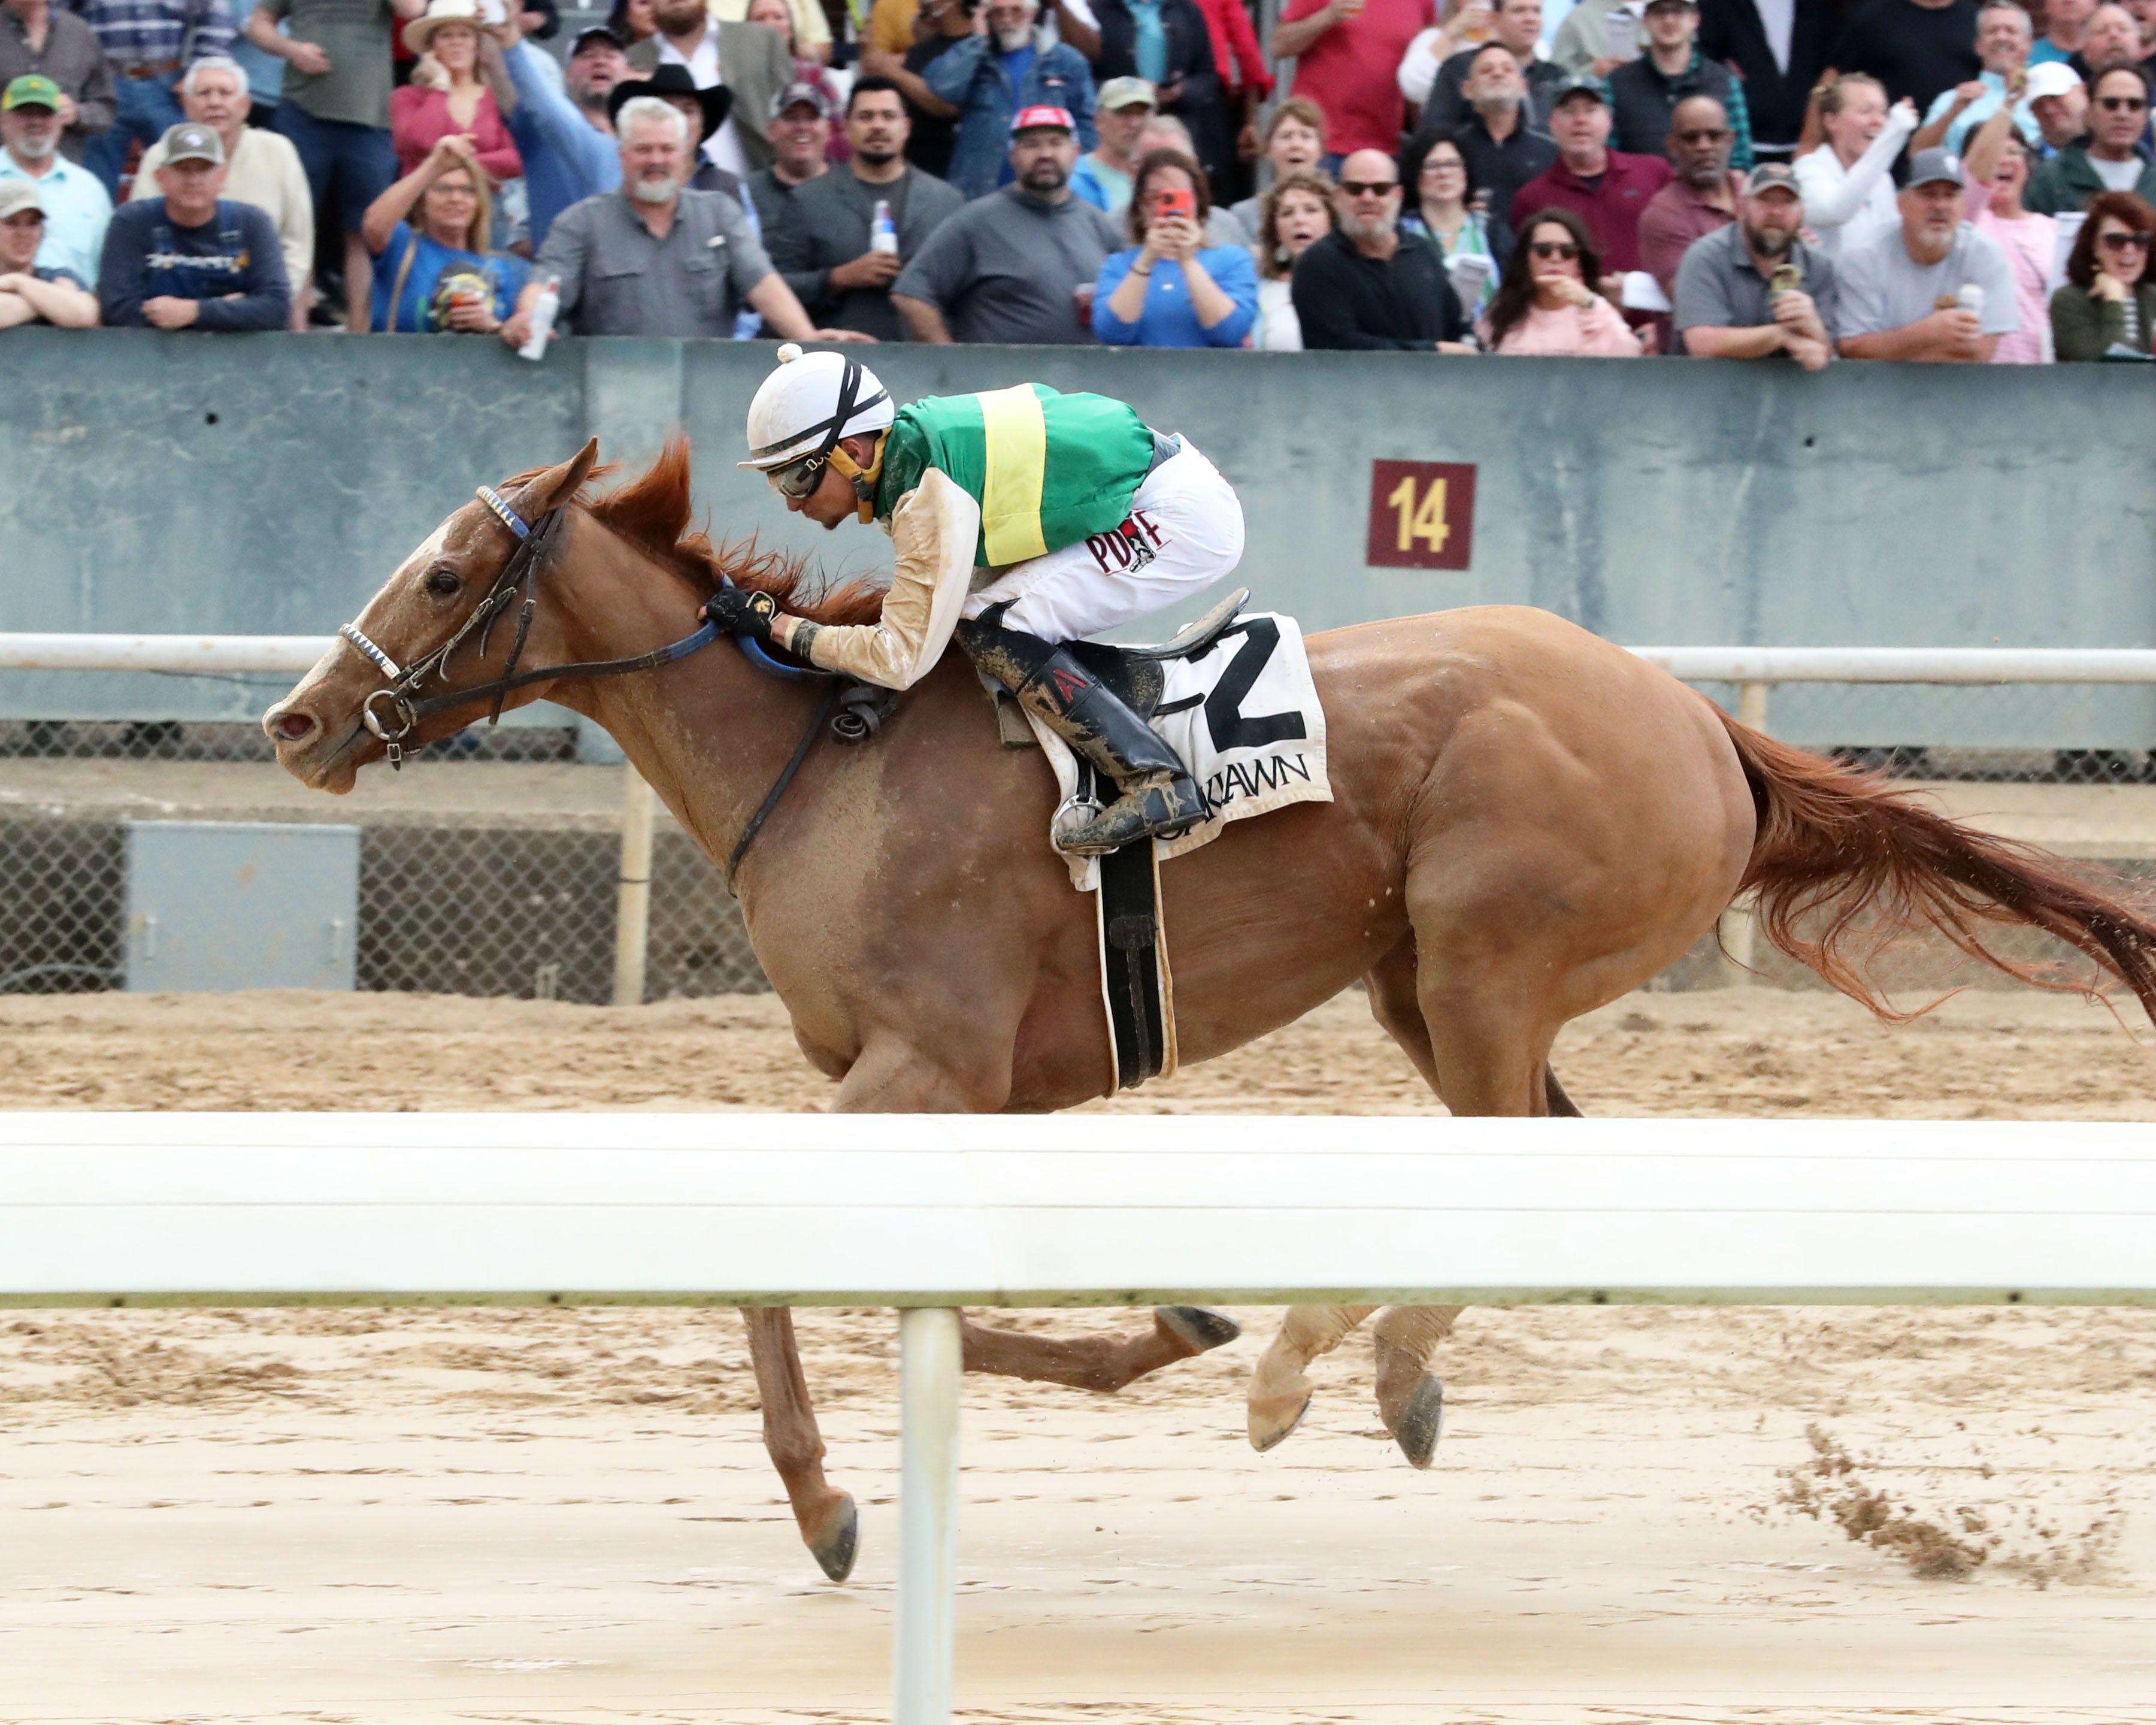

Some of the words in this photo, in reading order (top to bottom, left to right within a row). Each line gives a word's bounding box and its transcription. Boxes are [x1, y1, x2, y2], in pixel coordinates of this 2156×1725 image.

[1388, 476, 1450, 552] 14
[1185, 617, 1307, 753] 2
[1154, 753, 1311, 840] KLAWN
